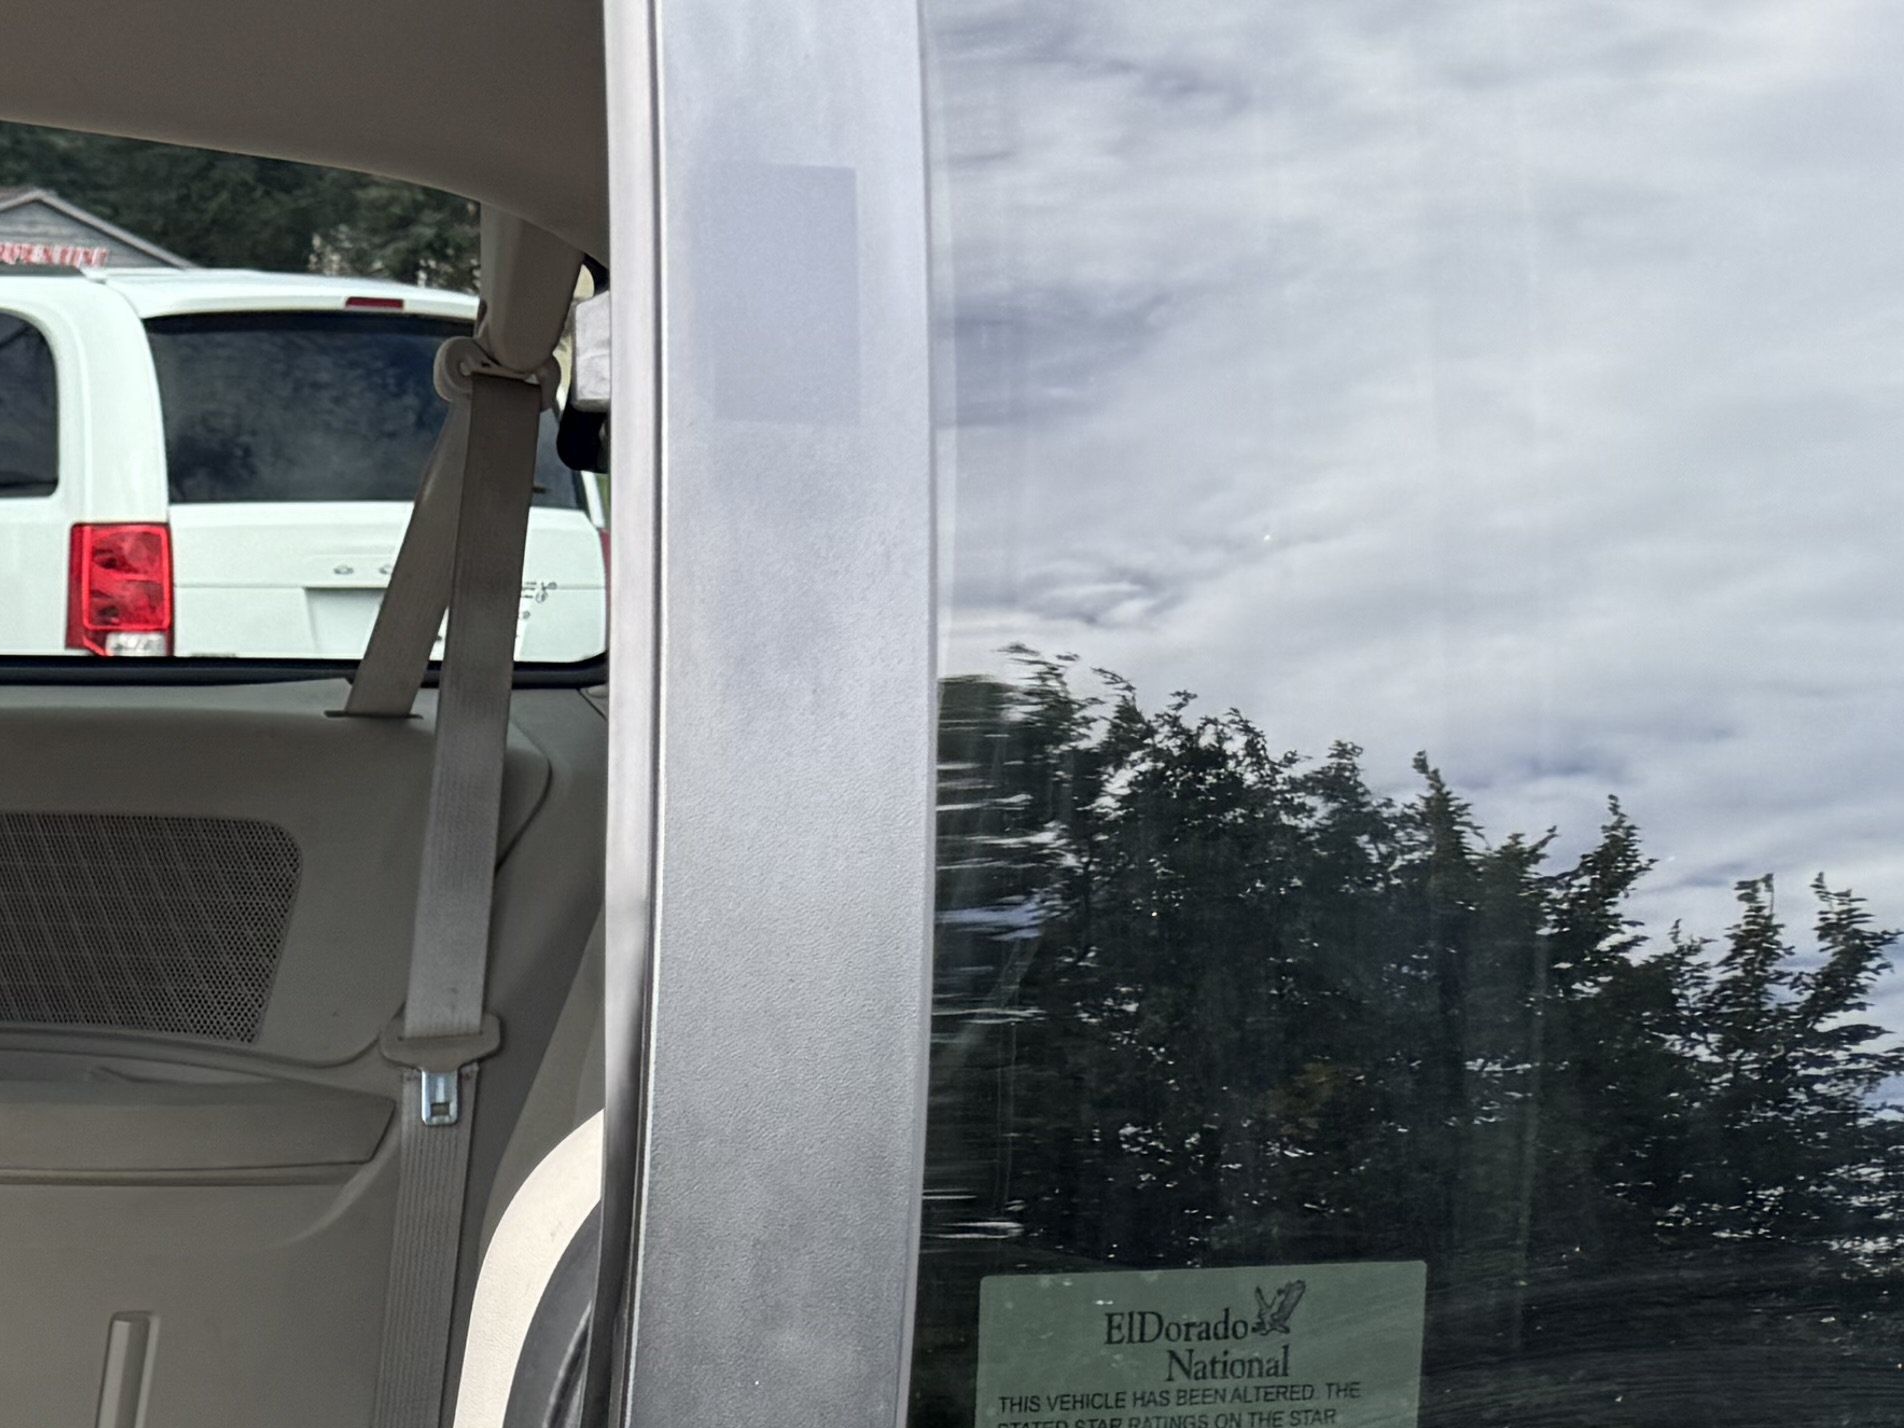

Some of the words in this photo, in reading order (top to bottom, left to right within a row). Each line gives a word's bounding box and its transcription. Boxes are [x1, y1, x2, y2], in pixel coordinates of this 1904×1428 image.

[1104, 1307, 1249, 1345] ElDorado
[1165, 1343, 1290, 1382] National
[998, 1395, 1041, 1414] THIS
[1047, 1391, 1127, 1412] VEHICLE
[1132, 1389, 1171, 1408] HAS
[1176, 1386, 1226, 1407] BEEN
[1325, 1381, 1361, 1400] THE
[1247, 1409, 1286, 1428] THE
[1289, 1407, 1337, 1427] STAR
